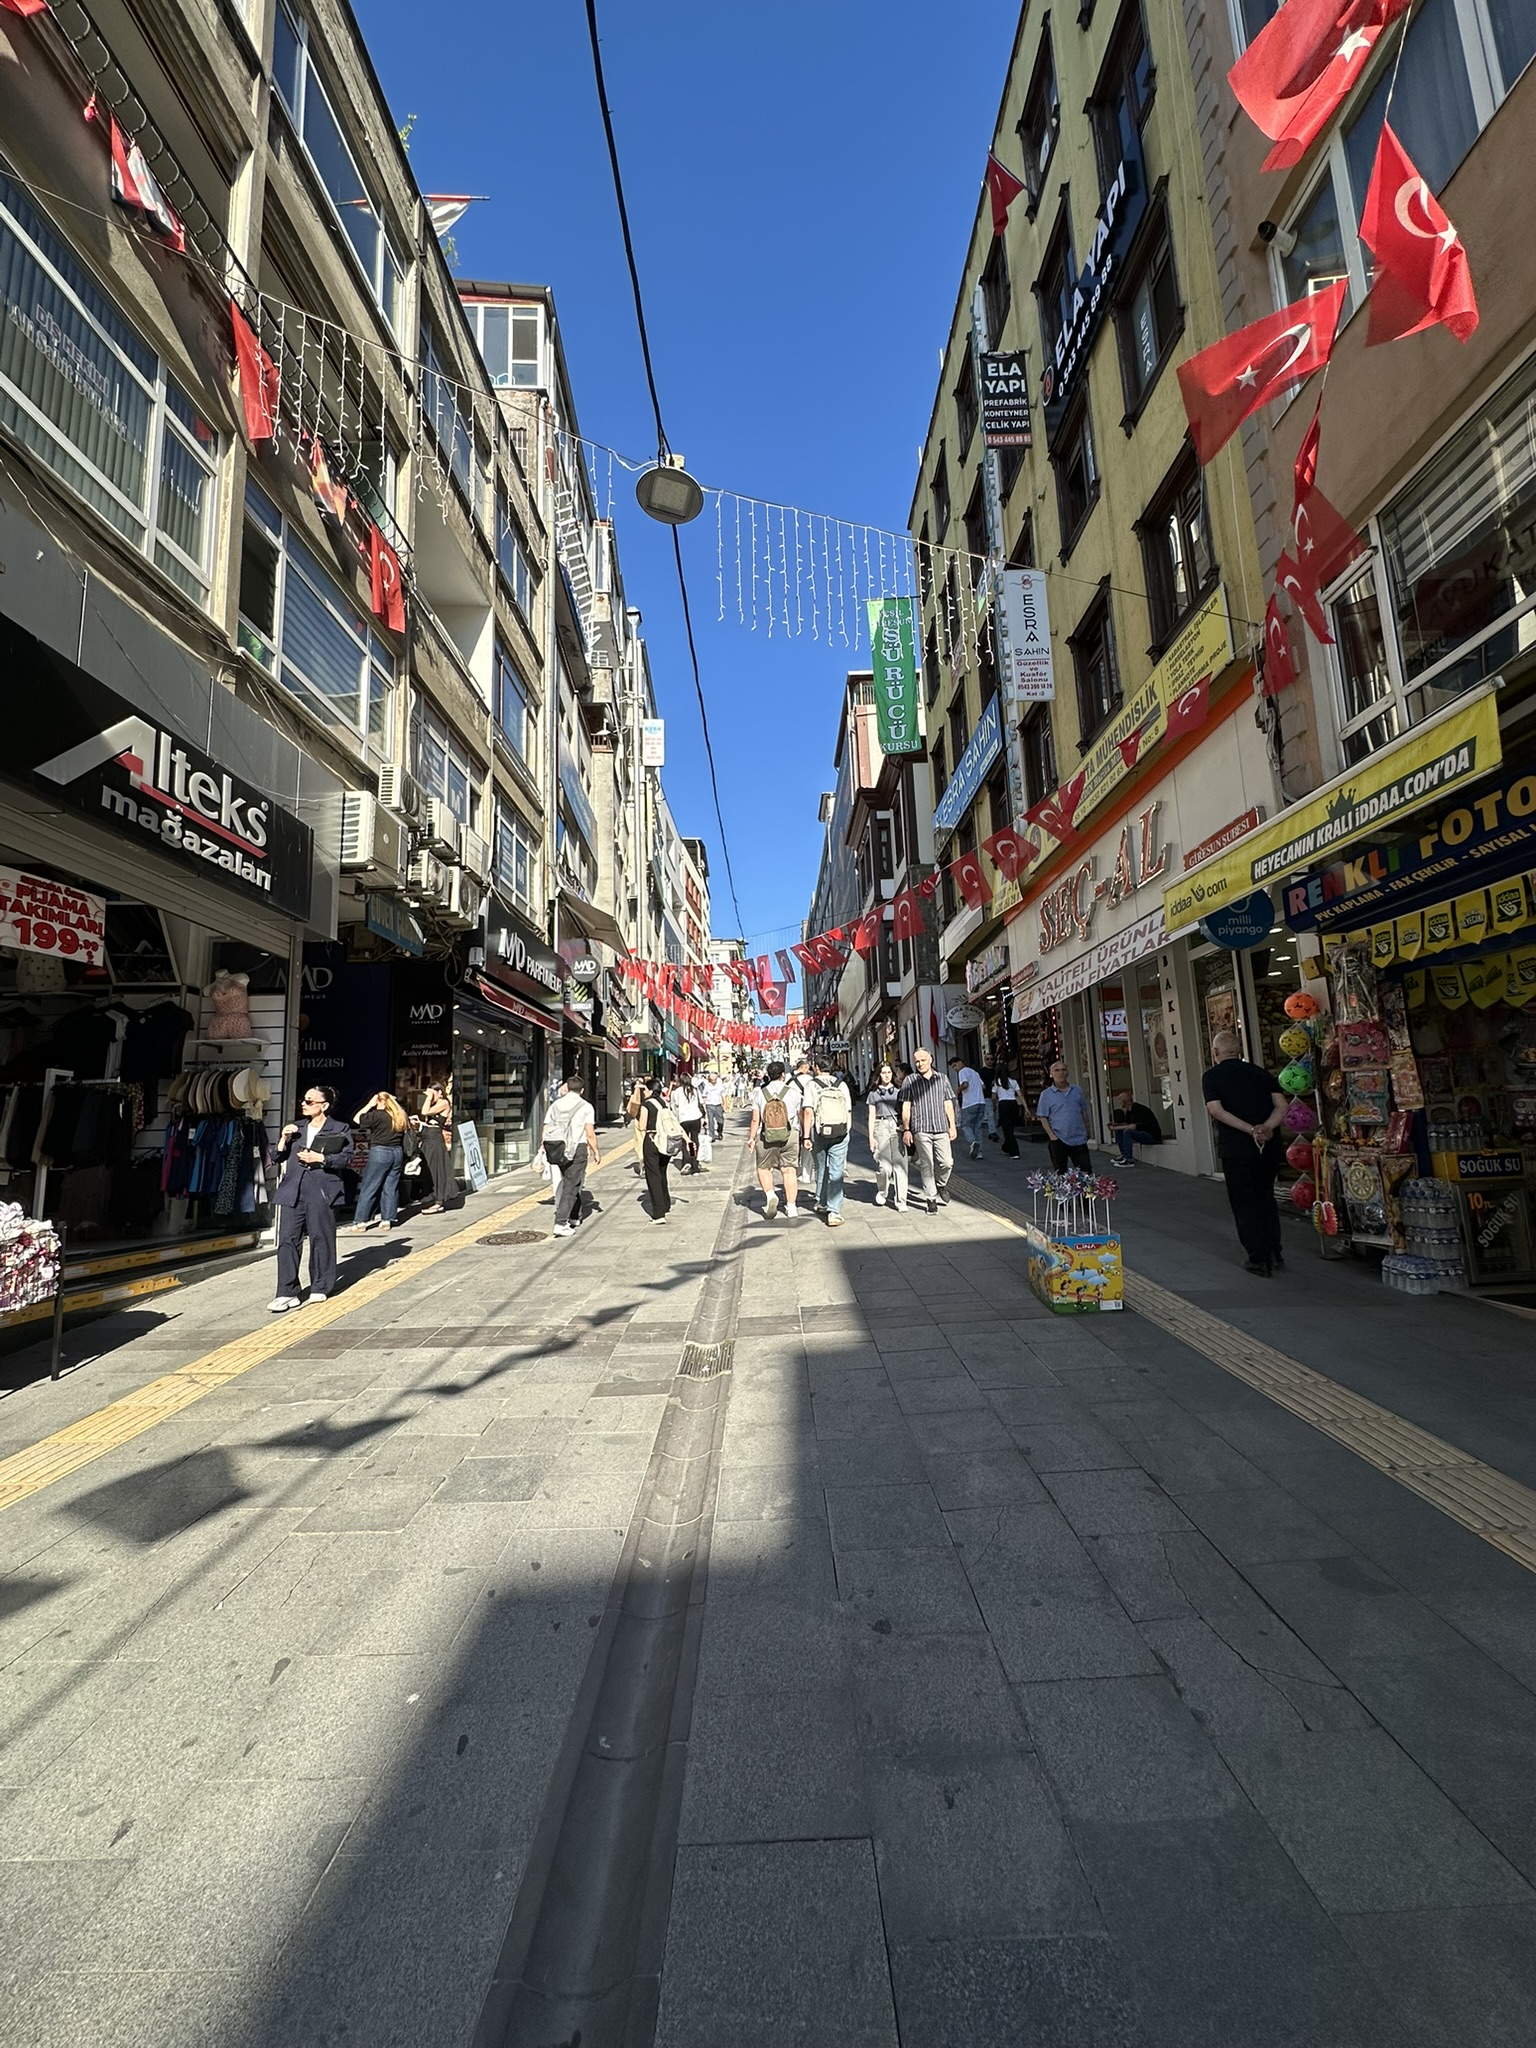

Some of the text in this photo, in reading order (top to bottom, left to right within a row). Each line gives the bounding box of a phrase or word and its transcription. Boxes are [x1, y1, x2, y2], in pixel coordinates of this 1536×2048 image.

[1054, 160, 1127, 370] ELA YAPI
[62, 333, 110, 399] HEKİMİ
[985, 379, 1026, 393] YAPI
[987, 362, 1022, 377] ELA
[984, 397, 1027, 407] PREFABRİK
[985, 409, 1029, 417] KONTEYNER
[986, 420, 1030, 430] ÇELİK YAPI
[1023, 594, 1039, 643] ESRA
[882, 627, 907, 740] SÜRÜCÜ
[1095, 680, 1158, 761] MÜHENDİSLİK
[33, 715, 268, 848] Alteks
[941, 768, 966, 822] ESRA
[100, 784, 272, 892] mağazaları
[1253, 829, 1315, 881] HEYECANIN
[1315, 809, 1353, 850] KRALI
[1038, 800, 1168, 957] SEÇ-AL
[1314, 906, 1334, 923] PVC
[1333, 888, 1384, 918] KAPLAMA
[1390, 875, 1413, 893] FAX
[1469, 828, 1532, 860] SAYISAL
[1497, 887, 1521, 903] iddaa
[0, 894, 104, 938] TAKIMLARI
[16, 882, 91, 918] PİJAMA
[1169, 877, 1228, 919] iddaa com
[1218, 924, 1264, 936] piyango
[1228, 914, 1252, 925] milli
[1428, 914, 1449, 928] iddaa
[573, 959, 597, 973] MAD
[1037, 954, 1093, 996] KALİTELİ
[1042, 979, 1085, 1008] UYGUN
[1088, 931, 1172, 985] FİYATLAR
[408, 1002, 444, 1020] MAD
[1459, 1156, 1521, 1174] SOĞUK SU
[1477, 1208, 1510, 1248] SOĞUK
